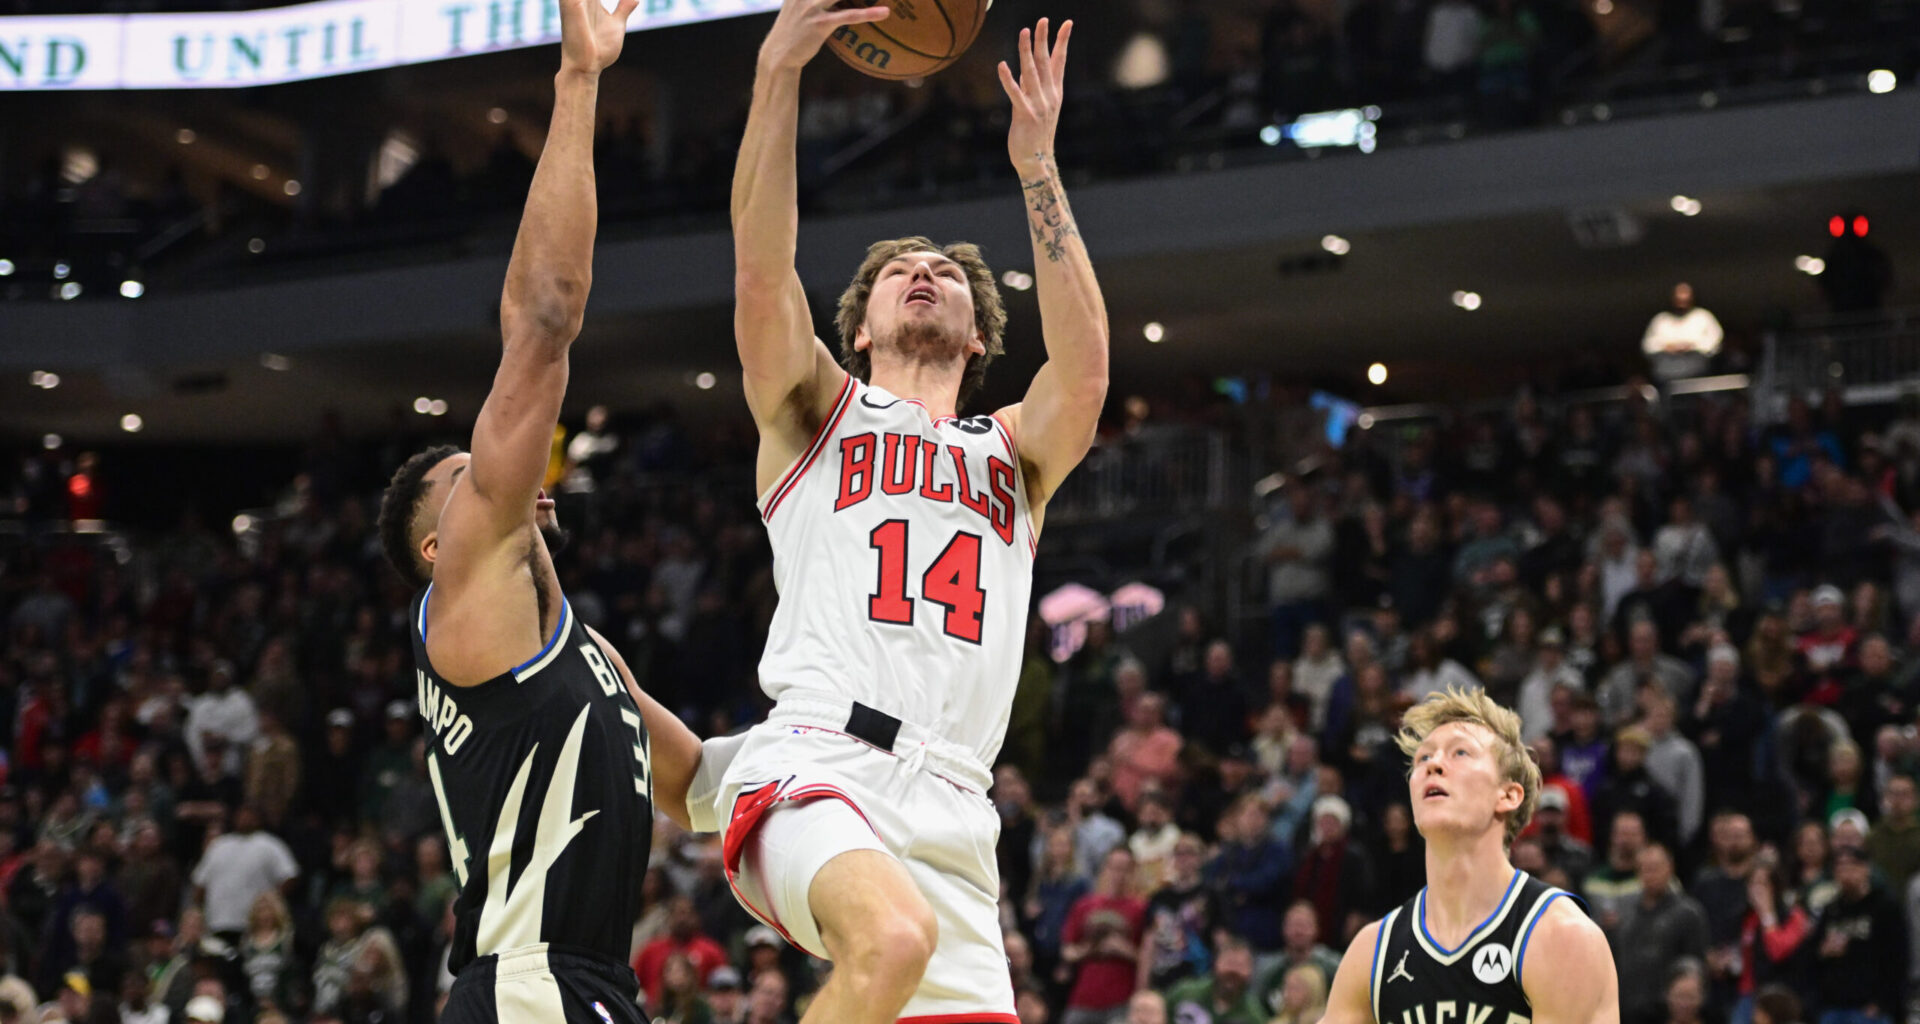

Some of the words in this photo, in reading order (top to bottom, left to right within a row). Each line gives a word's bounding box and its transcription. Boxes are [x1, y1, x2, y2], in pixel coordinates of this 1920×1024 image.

[172, 18, 378, 82] UNTIL
[833, 431, 1017, 547] BULLS
[868, 518, 986, 646] 14
